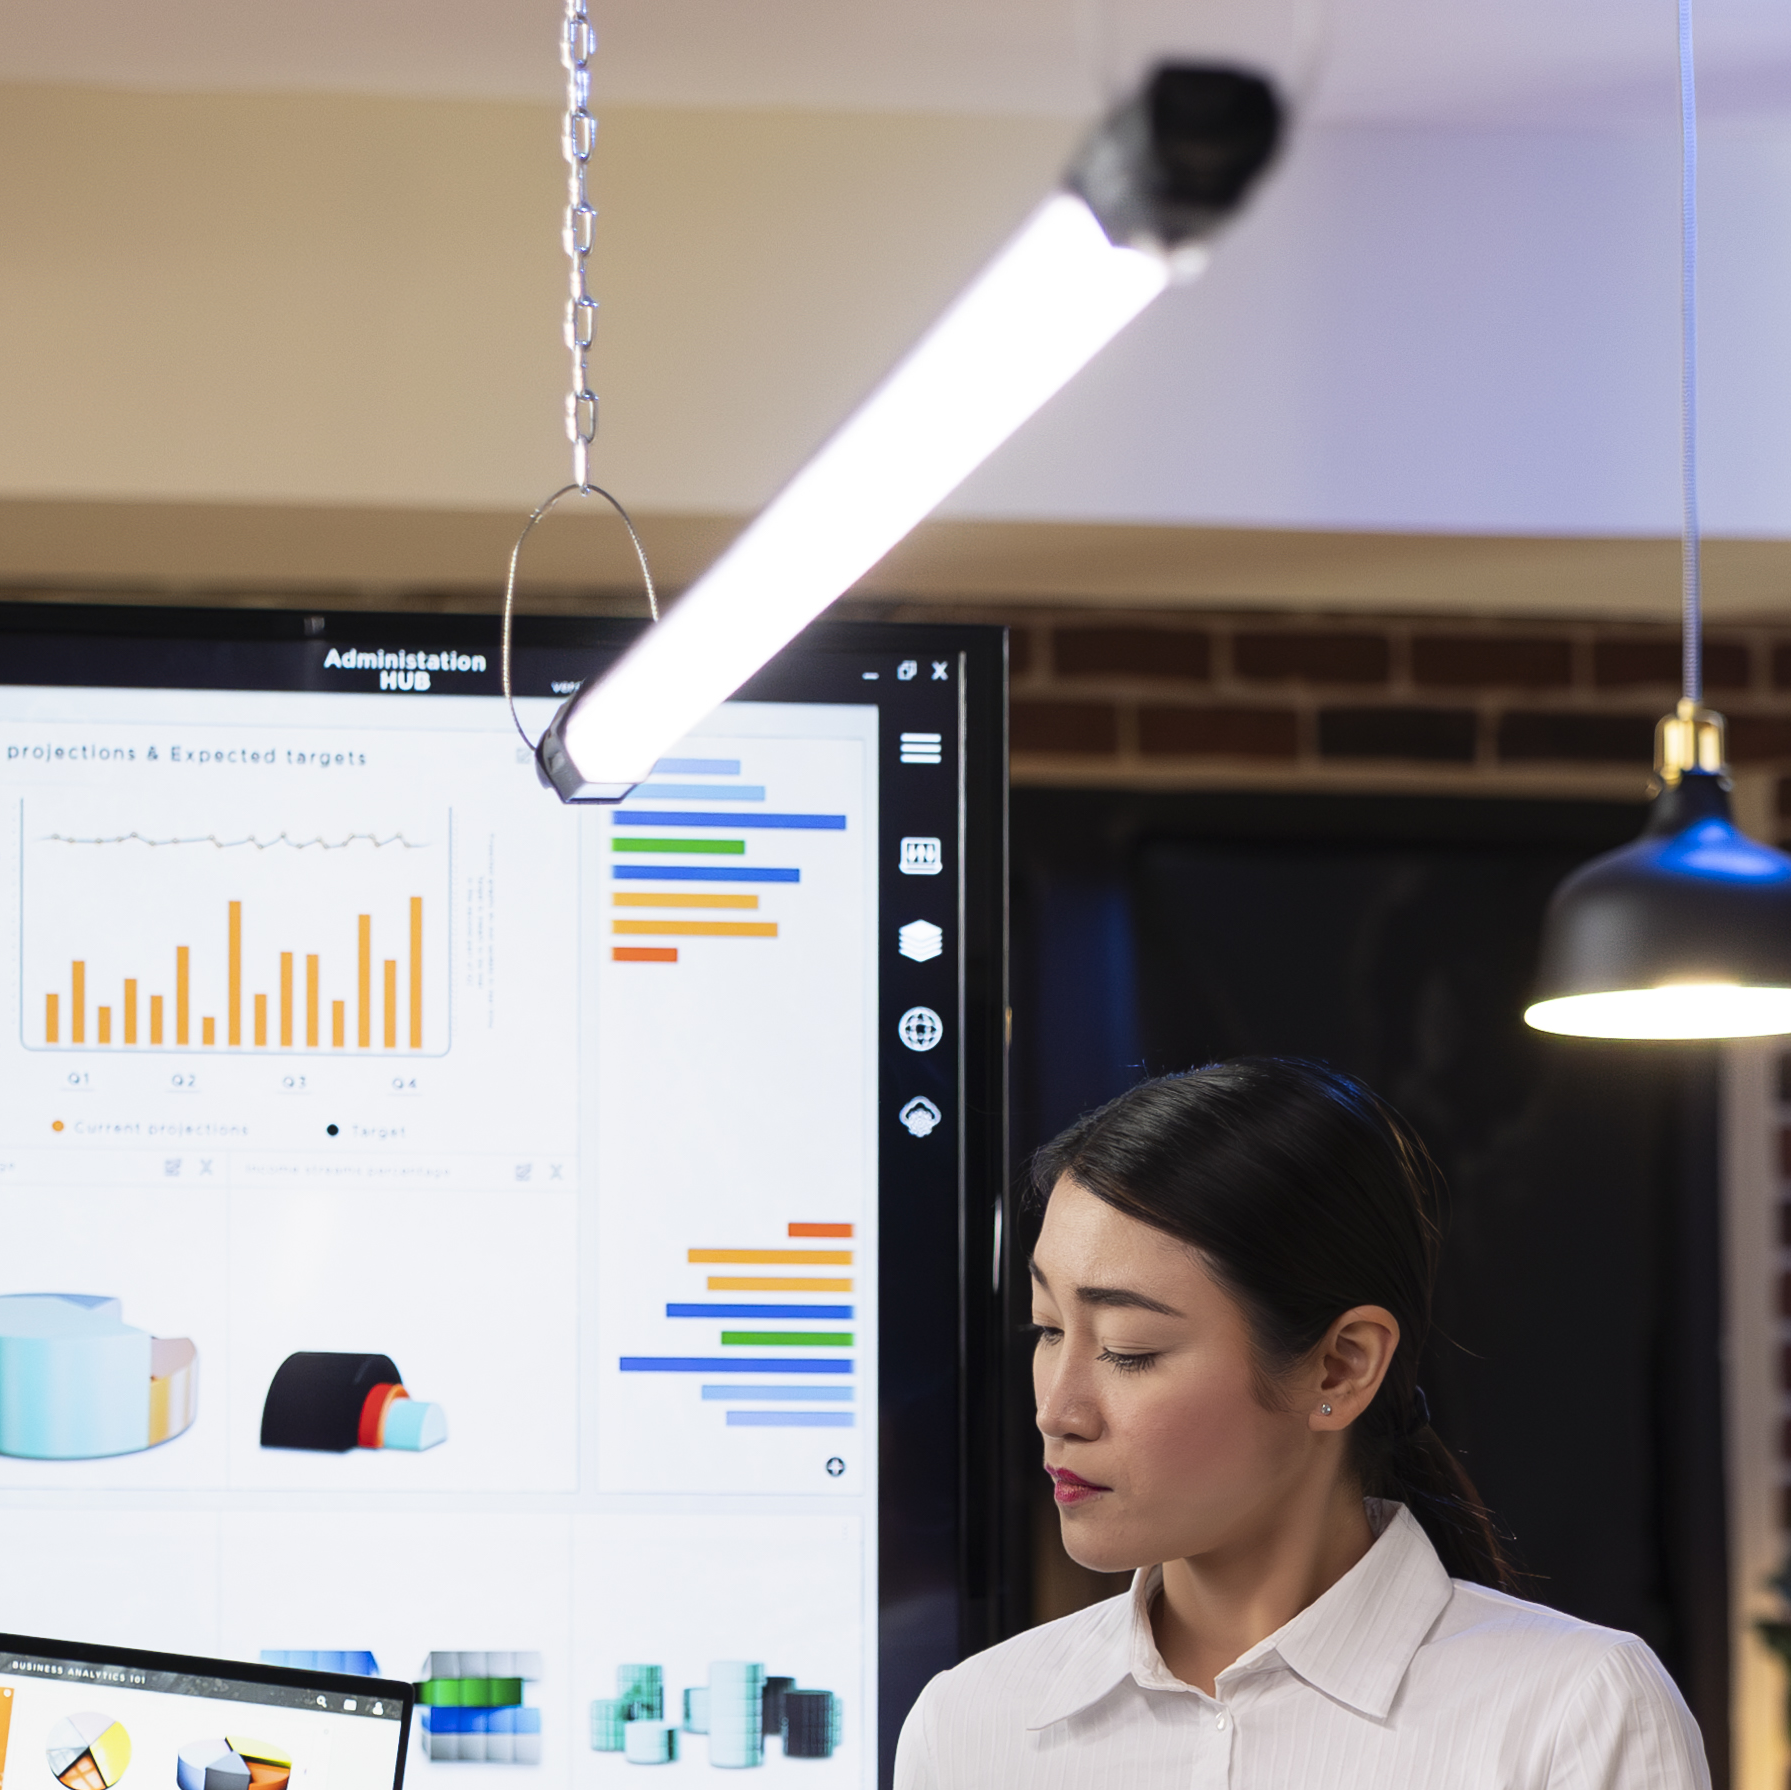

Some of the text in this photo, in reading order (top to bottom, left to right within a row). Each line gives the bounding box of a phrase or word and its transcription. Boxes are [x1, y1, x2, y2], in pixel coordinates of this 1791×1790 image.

[323, 647, 487, 672] Administation
[379, 670, 431, 691] HUB
[7, 743, 136, 763] projections
[147, 745, 159, 762] &
[171, 745, 276, 765] Expected
[287, 749, 367, 768] targets
[74, 1121, 249, 1137] Current projections
[352, 1124, 406, 1139] Target
[11, 1660, 146, 1685] BUSINESS ANALYTICS 101
